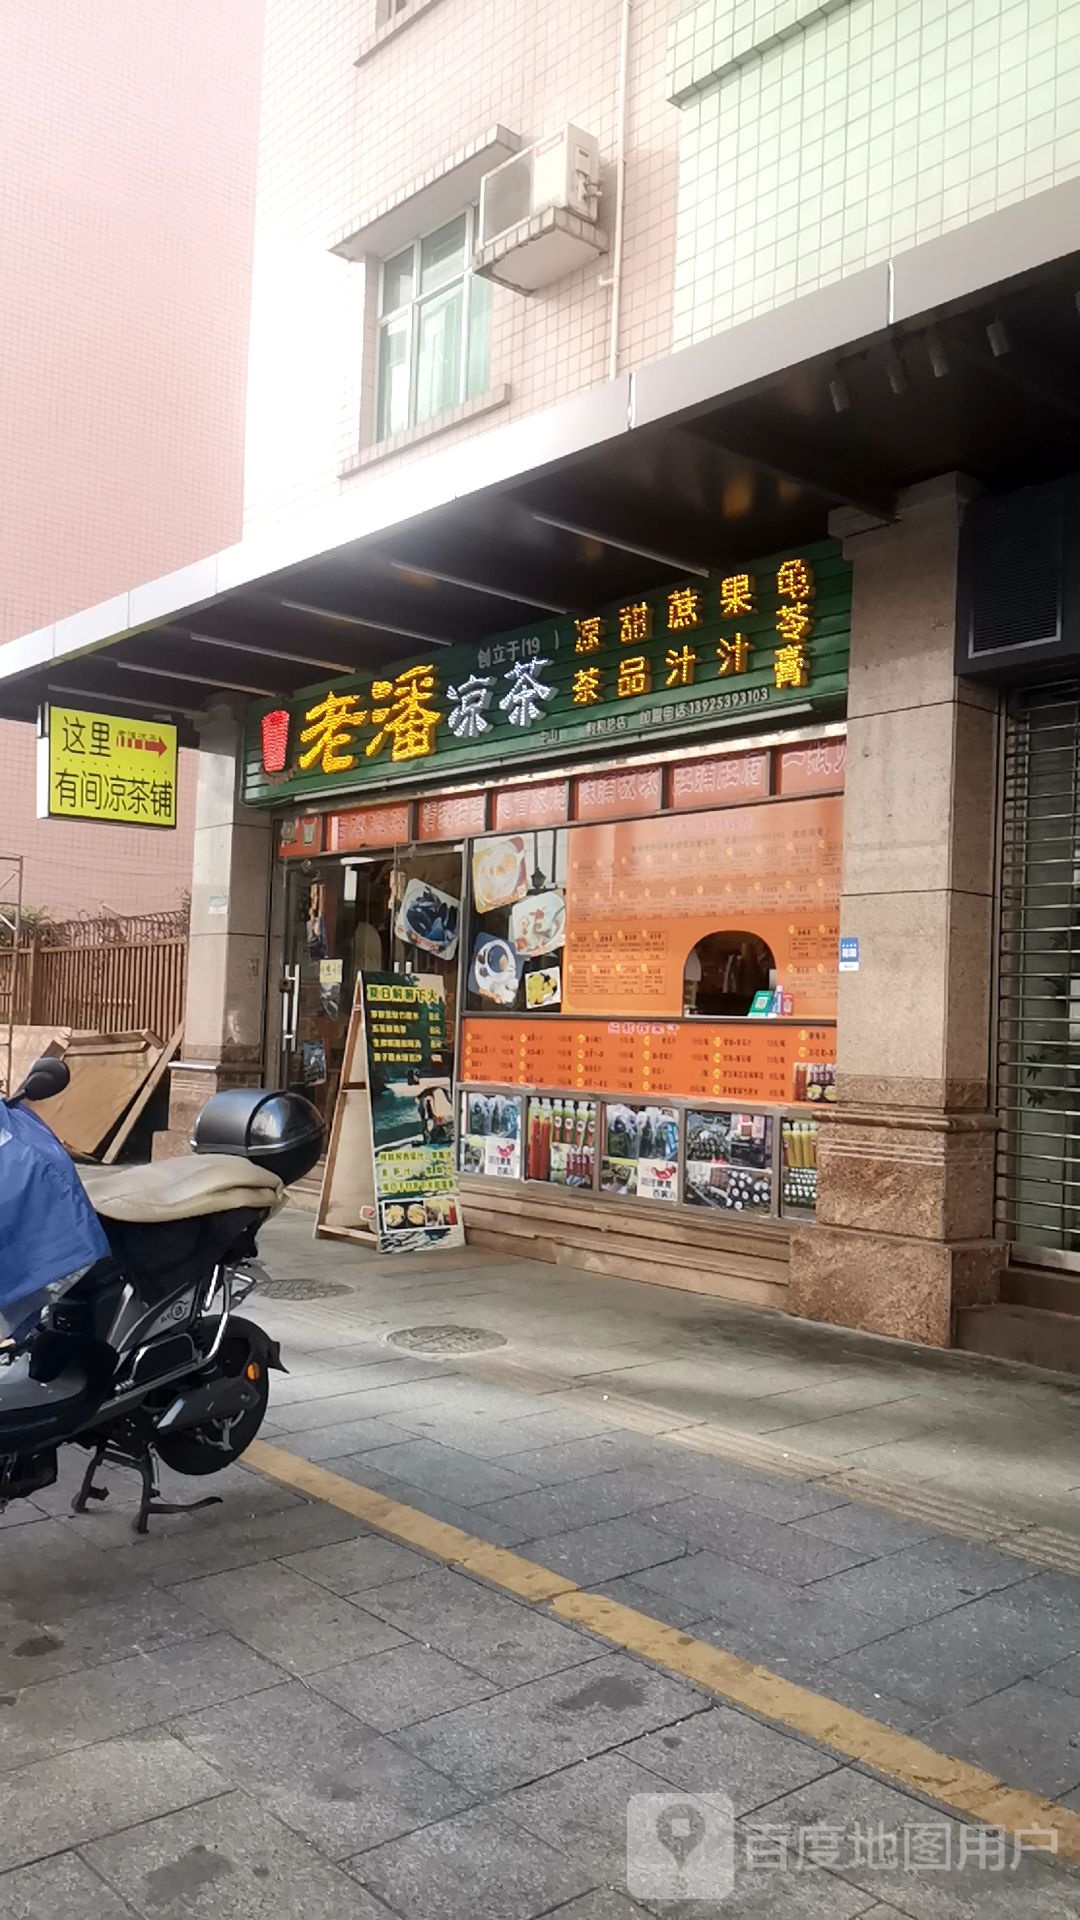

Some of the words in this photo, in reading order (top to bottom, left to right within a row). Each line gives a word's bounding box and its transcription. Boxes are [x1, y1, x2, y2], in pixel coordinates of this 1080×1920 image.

[571, 616, 602, 705] 凉茶
[618, 601, 651, 697] 甜品
[664, 587, 698, 685] 蔗汁
[716, 574, 752, 673] 果汁
[774, 559, 812, 689] 龟苓膏
[62, 716, 112, 758] 这里
[55, 768, 173, 817] 有间凉茶铺
